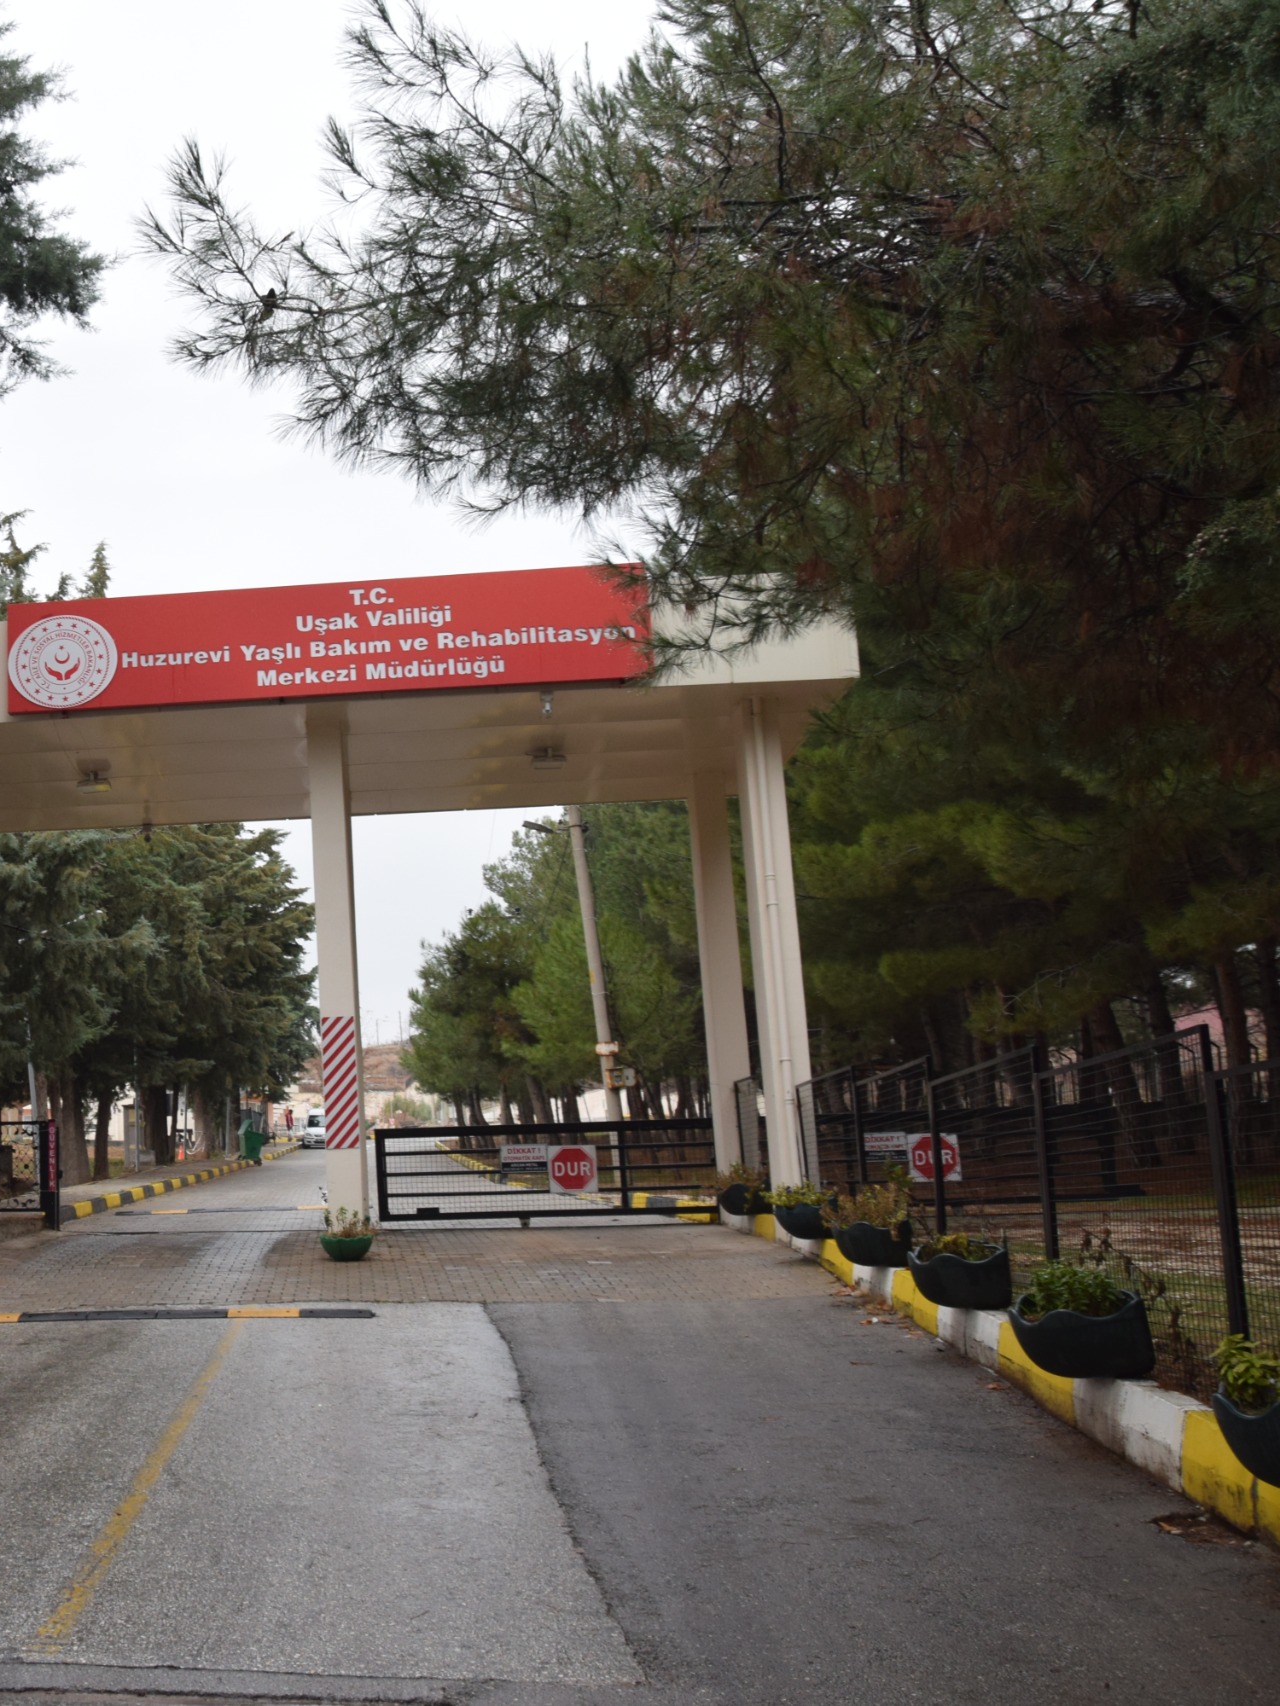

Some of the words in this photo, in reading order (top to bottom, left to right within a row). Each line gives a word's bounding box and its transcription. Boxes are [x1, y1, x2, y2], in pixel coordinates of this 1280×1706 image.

[349, 587, 395, 606] T.C.
[296, 612, 359, 636] Uşak
[365, 605, 452, 628] Valiliği
[121, 645, 231, 669] Huzurevi
[239, 642, 301, 665] Yaşlı
[310, 639, 391, 659] Bakım
[398, 635, 429, 652] ve
[436, 624, 637, 650] Rehabilitasyon
[257, 664, 357, 687] Merkezi
[365, 655, 505, 680] Müdürlüğü
[553, 1161, 591, 1177] DUR
